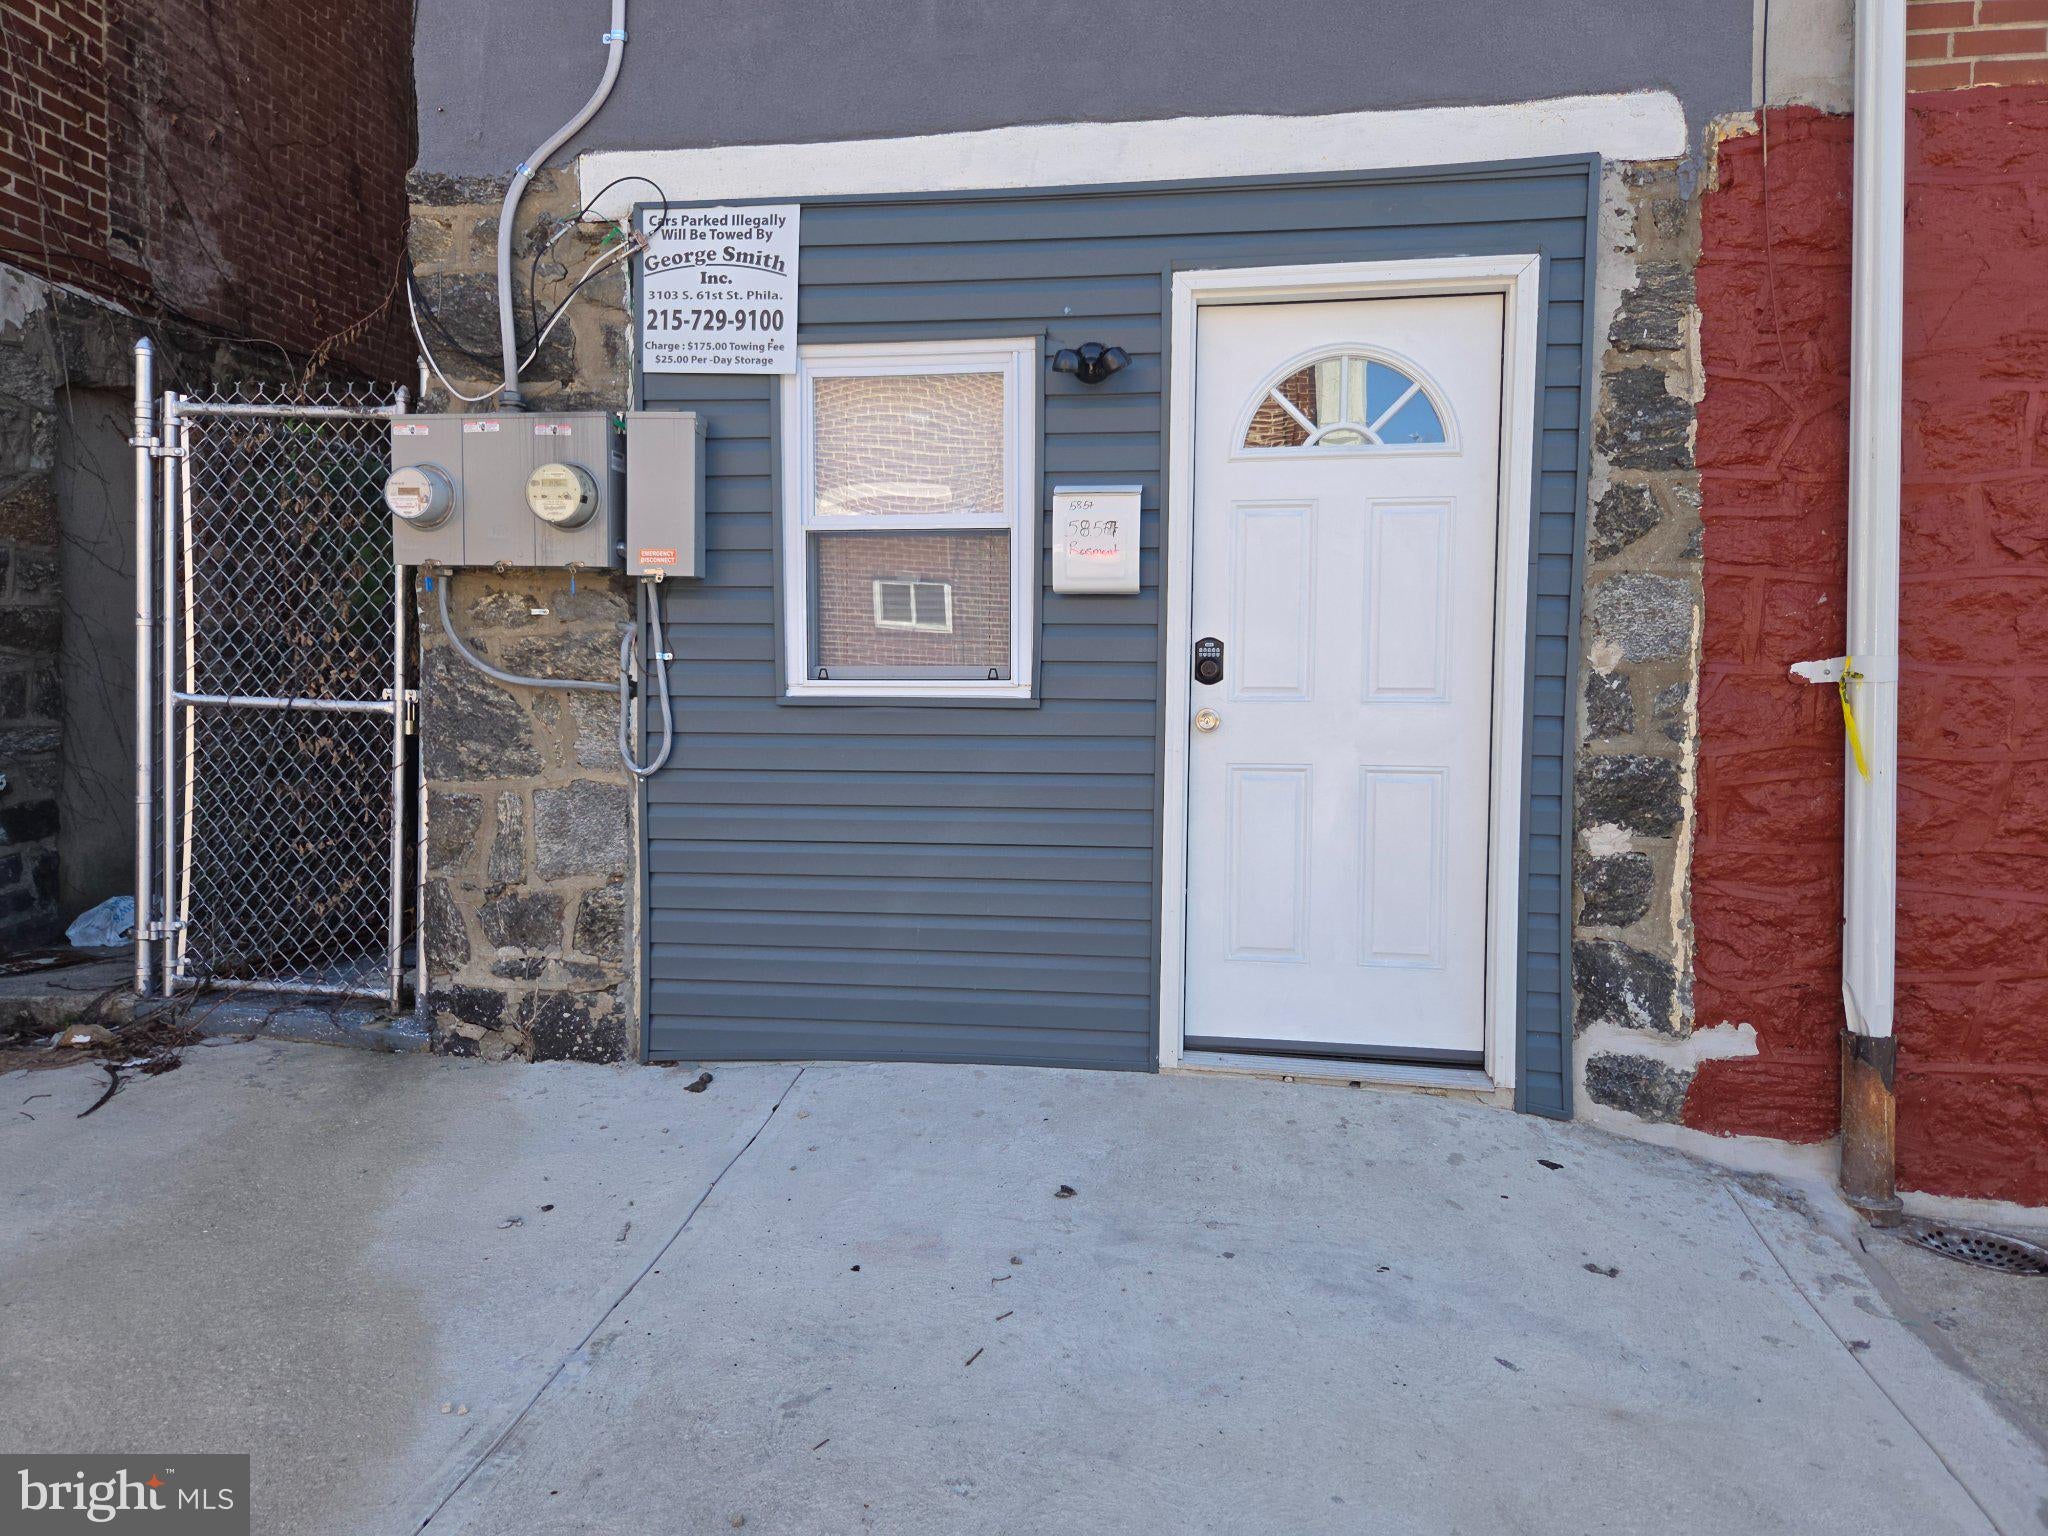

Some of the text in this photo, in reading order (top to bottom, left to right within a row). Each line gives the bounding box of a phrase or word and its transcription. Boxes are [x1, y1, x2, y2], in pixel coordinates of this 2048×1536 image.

[649, 214, 786, 228] Cars Parked Illegally
[661, 229, 773, 242] Will Be Towed By
[645, 246, 785, 272] George Smith
[700, 272, 732, 284] Inc.
[649, 291, 783, 300] 3103 S. 61st St. Phila.
[647, 309, 784, 331] 215-729-9100
[645, 341, 680, 352] Charge
[688, 342, 727, 351] $175.00
[730, 342, 764, 353] Towing
[768, 343, 784, 351] Fee
[655, 355, 688, 364] $25.00
[691, 356, 707, 364] Per
[735, 356, 773, 365] Storage
